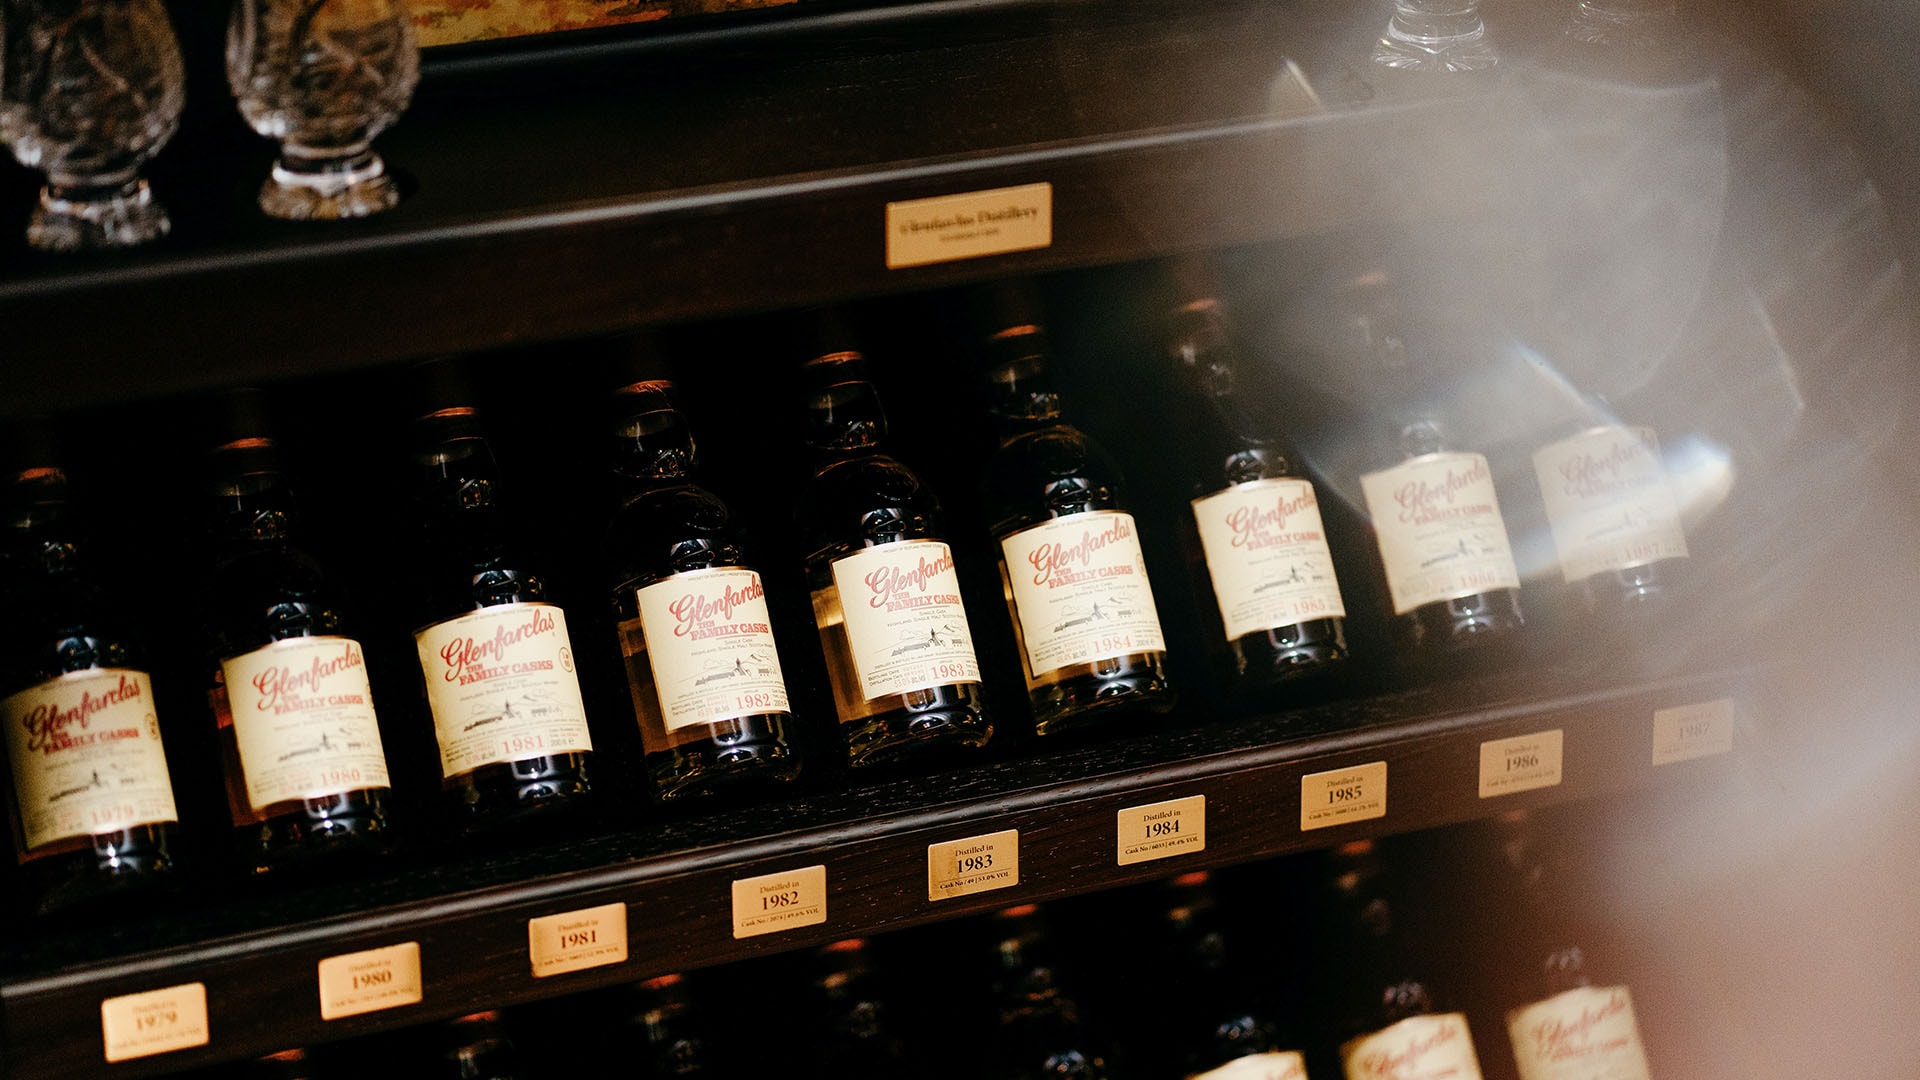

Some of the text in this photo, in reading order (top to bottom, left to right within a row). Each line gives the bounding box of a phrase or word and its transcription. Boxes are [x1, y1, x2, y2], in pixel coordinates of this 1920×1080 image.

[1048, 565, 1133, 589] FAMILY CASKS
[887, 594, 933, 612] FAMILY
[1292, 598, 1326, 615] 1985
[690, 623, 769, 641] FAMILY CASKS
[440, 608, 555, 682] Glenfarclas
[1093, 635, 1132, 653] 1984
[459, 660, 554, 686] FAMILY CASKS
[932, 663, 965, 680] 1983
[274, 697, 326, 716] FAMILY
[736, 693, 771, 710] 1982
[22, 675, 140, 752] Glenfarclas
[502, 735, 545, 755] 1981
[1507, 754, 1539, 771] 1986
[321, 768, 361, 787] 1980
[1329, 785, 1362, 804] 1985
[91, 804, 135, 825] 1979
[1143, 809, 1181, 822] Distilled in
[1146, 819, 1179, 838] 1984
[955, 844, 985, 856] Distilled
[958, 854, 993, 873] 1983
[759, 881, 790, 894] Distilled
[939, 882, 954, 890] Cask
[762, 891, 799, 910] 1982
[561, 929, 596, 949] 1981
[352, 970, 392, 990] 1980
